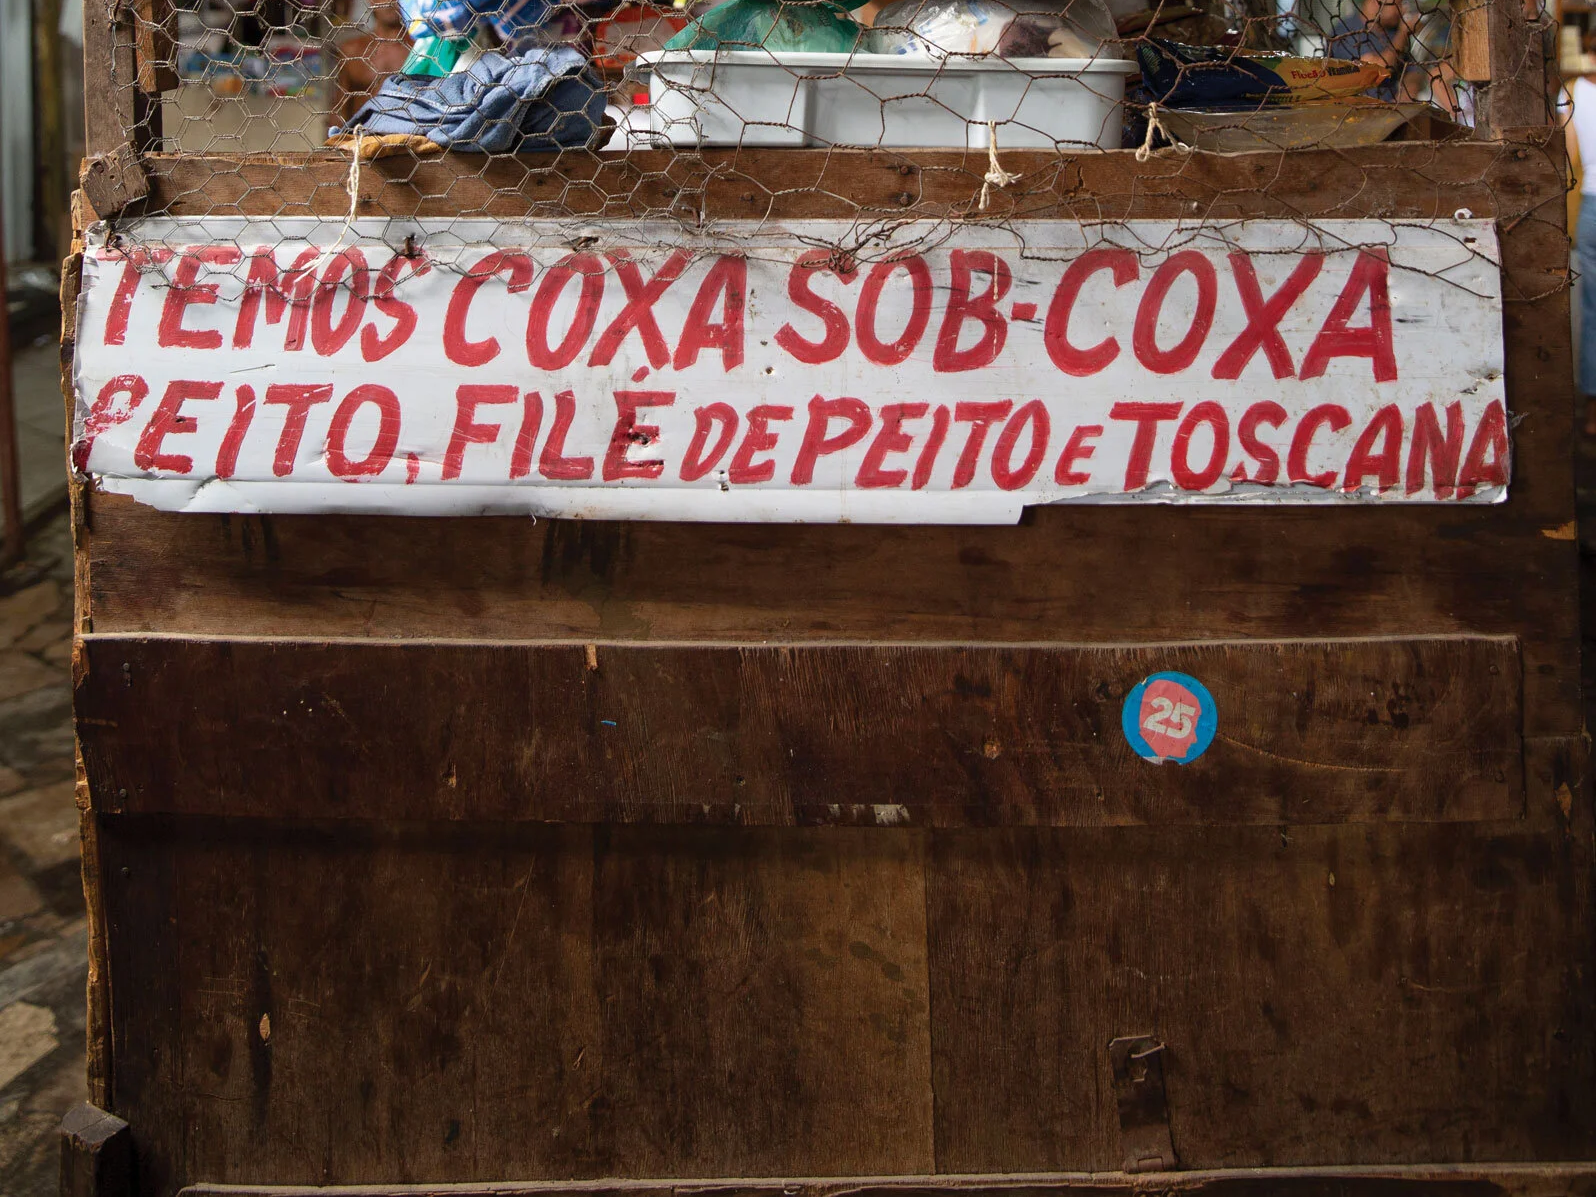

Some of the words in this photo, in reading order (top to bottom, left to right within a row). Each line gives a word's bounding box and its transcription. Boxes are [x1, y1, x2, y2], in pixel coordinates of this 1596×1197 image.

[95, 245, 432, 363] TEMOS
[442, 248, 748, 373] COXA
[774, 246, 1399, 384] SOB-COXA
[679, 401, 795, 484] DE
[789, 393, 1052, 492] PEITO
[1054, 424, 1105, 487] E
[1109, 399, 1509, 501] TOSCANA
[1142, 696, 1197, 740] 25
